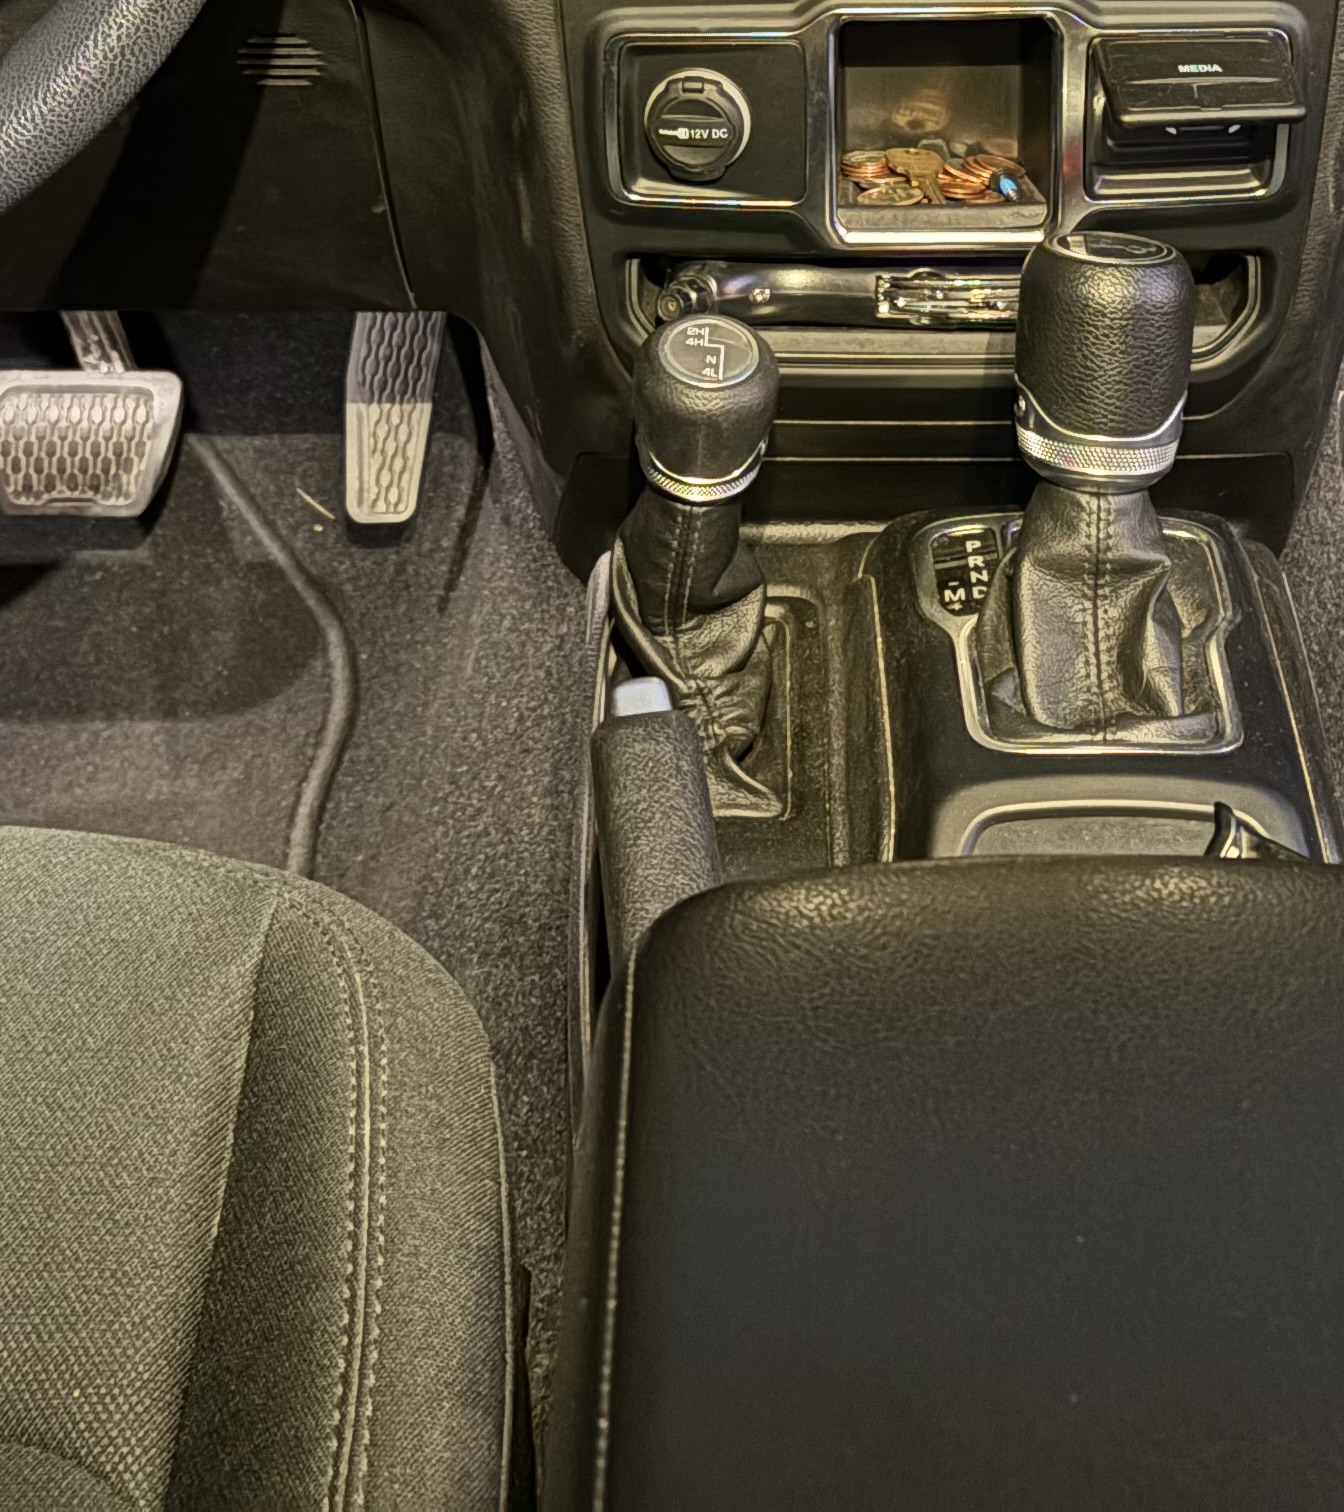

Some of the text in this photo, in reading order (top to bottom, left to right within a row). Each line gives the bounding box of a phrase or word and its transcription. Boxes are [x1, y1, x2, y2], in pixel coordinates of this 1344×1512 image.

[1177, 63, 1223, 73] MEDIA
[690, 128, 729, 139] 12V DC
[686, 326, 705, 336] 2H
[684, 337, 704, 347] 4H
[706, 354, 717, 365] N
[701, 367, 718, 378] 4L
[965, 540, 982, 553] P
[967, 555, 985, 568] R
[969, 569, 989, 583] N
[943, 587, 966, 603] M
